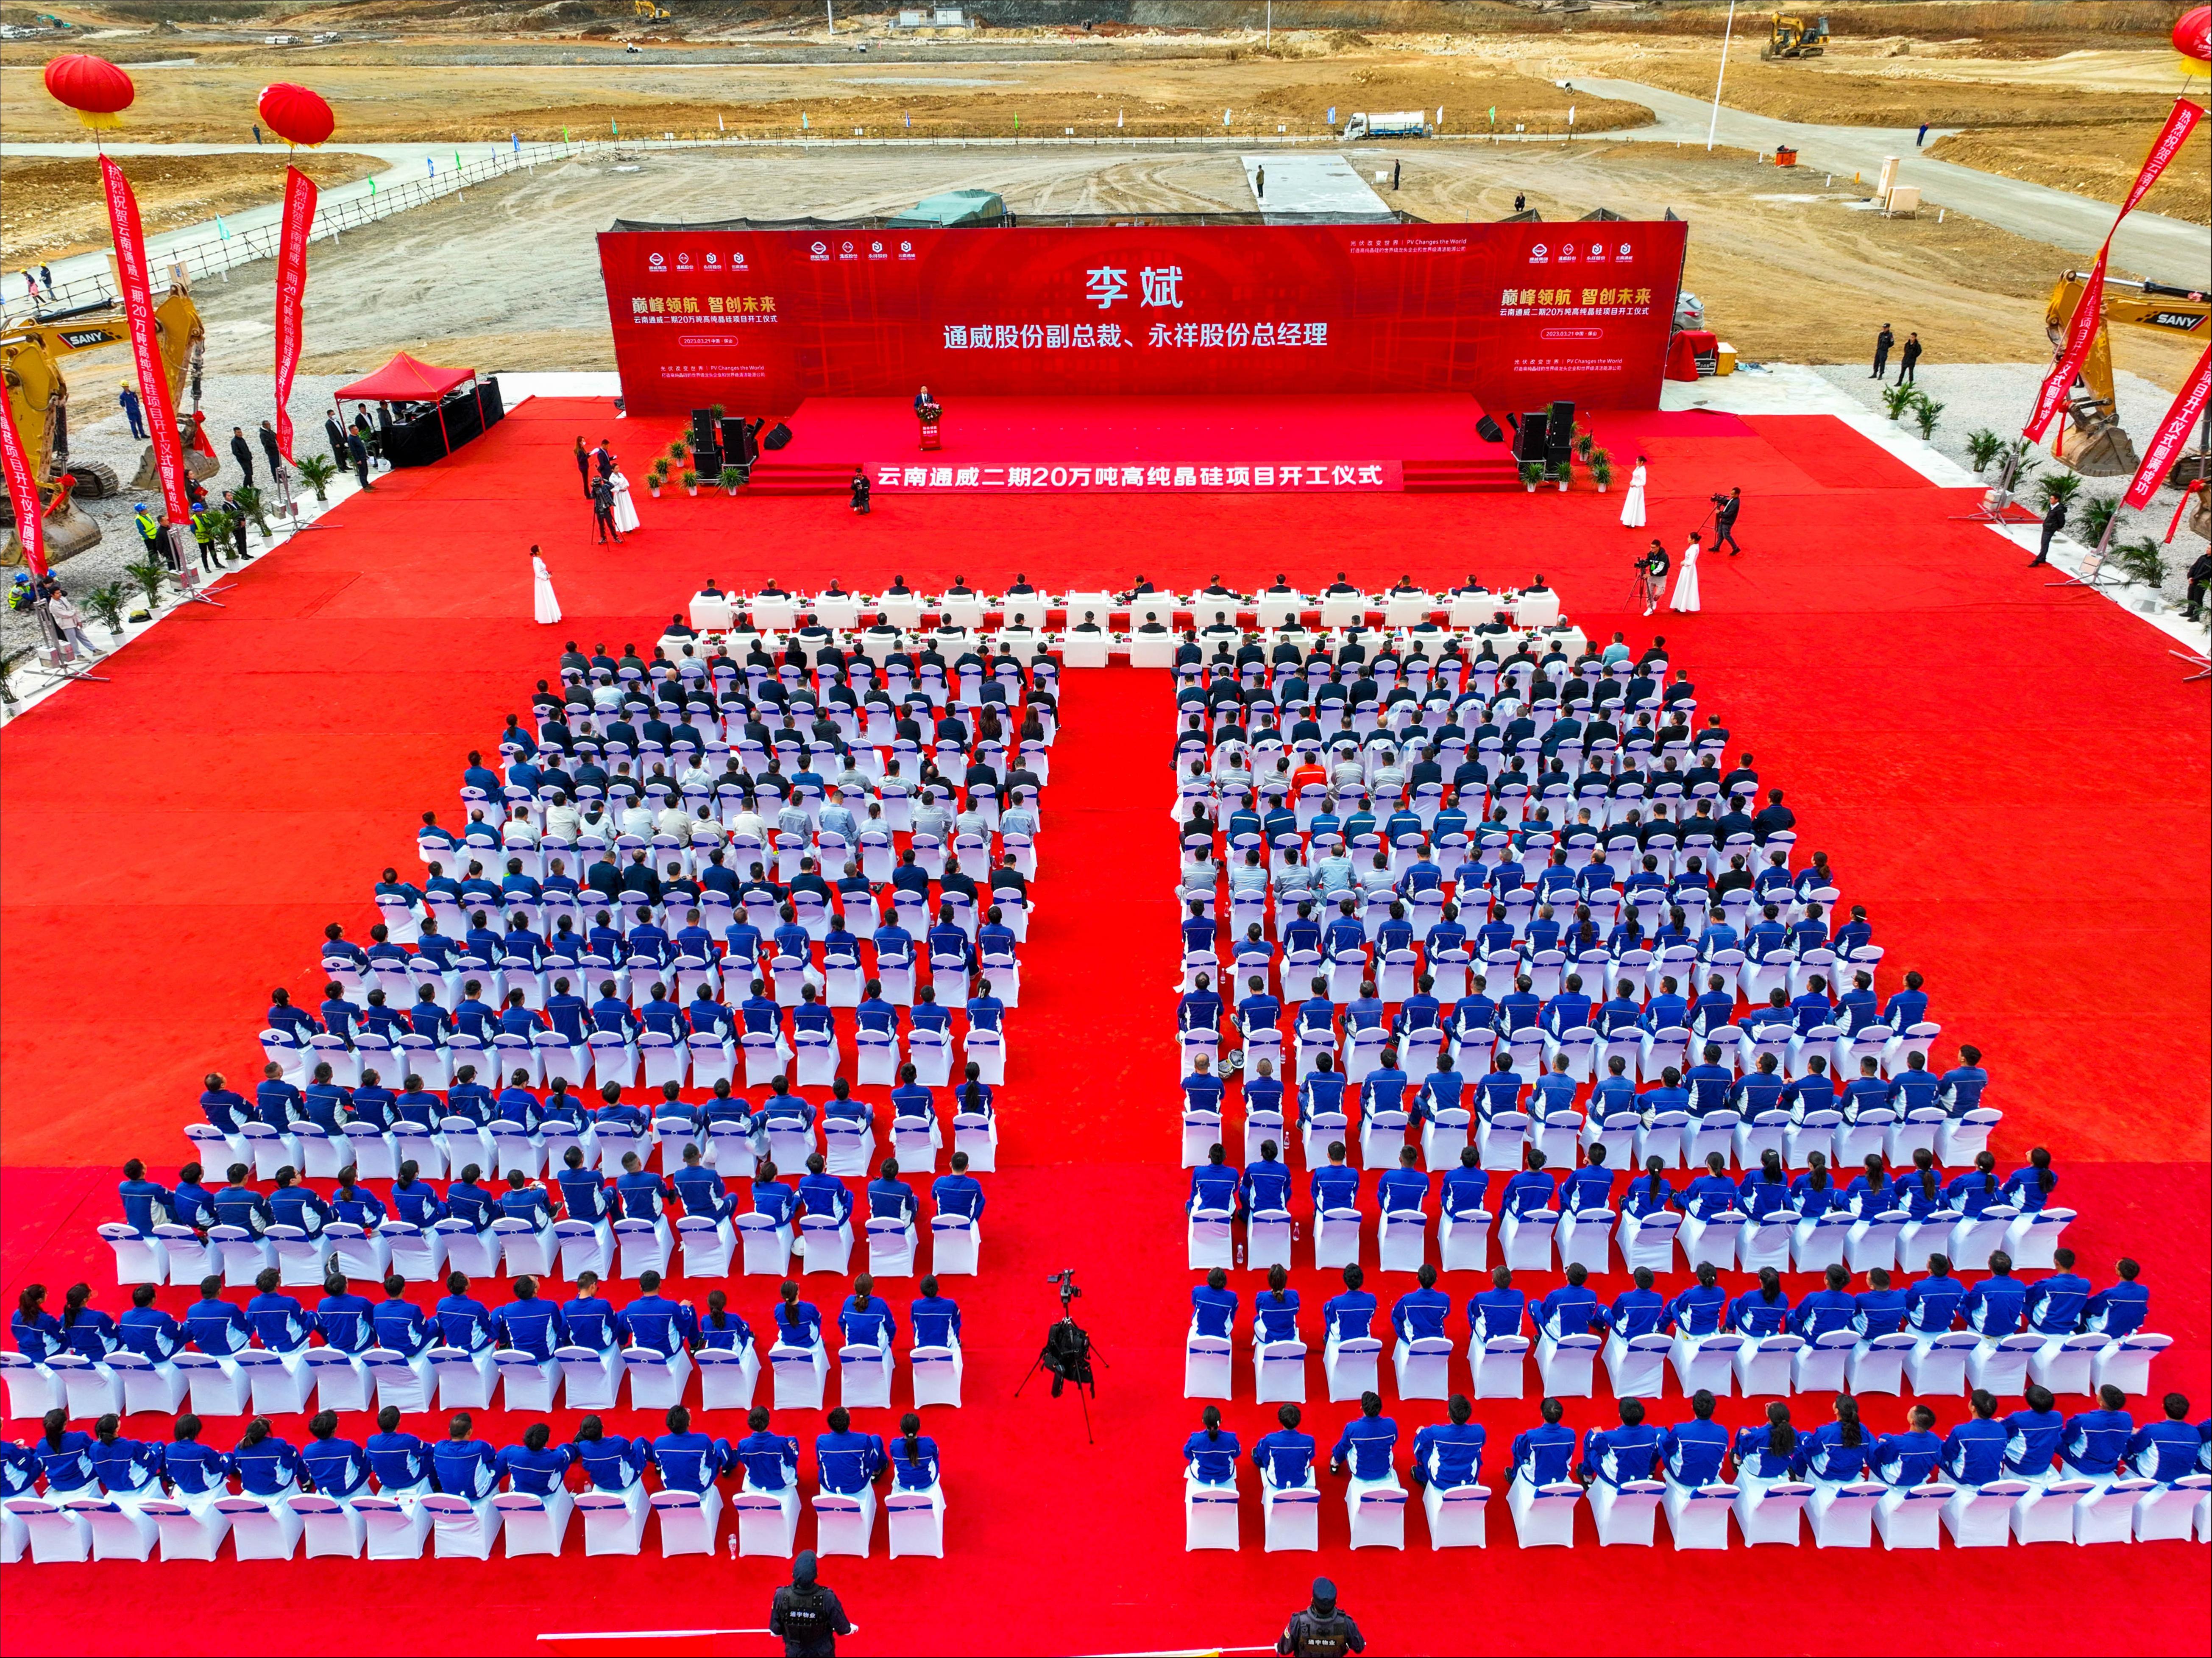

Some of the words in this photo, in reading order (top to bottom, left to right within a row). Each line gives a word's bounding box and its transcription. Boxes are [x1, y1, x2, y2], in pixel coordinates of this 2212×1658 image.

[1086, 266, 1183, 309] 李斌
[632, 297, 699, 314] 巅峰领航
[708, 296, 776, 313] 智创未来
[1501, 289, 1571, 306] 巅峰领航
[1582, 288, 1651, 305] 智创未来
[634, 315, 778, 324] 云南通威二期20万吨高纯晶硅项目开工仪式
[1499, 307, 1649, 316] 云南通威二期20万吨高纯晶硅项目开工仪式
[2156, 314, 2197, 327] SANY
[70, 332, 102, 345] SANY
[943, 322, 1327, 349] 通威股份副总裁、永祥股份总经理
[2135, 361, 2212, 496] 项目开工仪式圆满成功
[0, 403, 36, 554] 晶硅项目开工仪式圆满
[878, 465, 1383, 487] 云南通威二期20万吨高纯晶硅项目开工仪式
